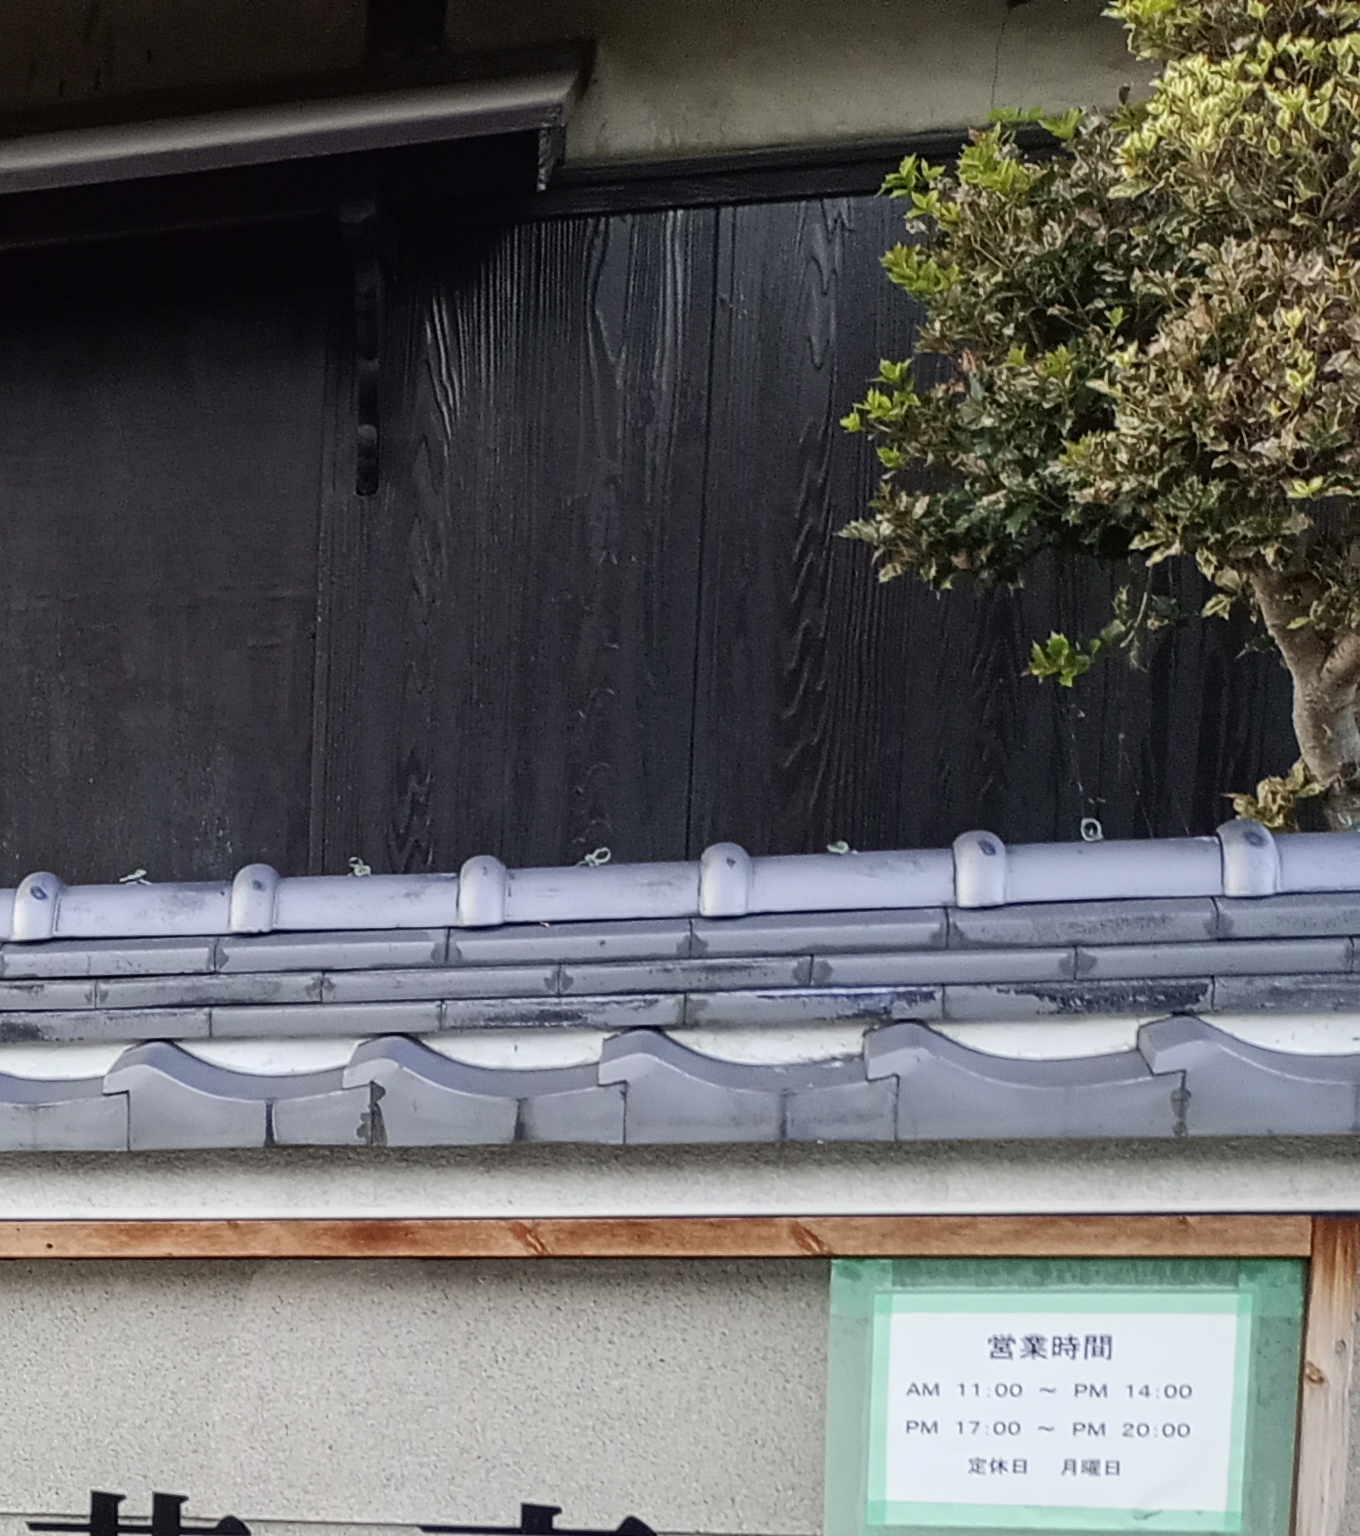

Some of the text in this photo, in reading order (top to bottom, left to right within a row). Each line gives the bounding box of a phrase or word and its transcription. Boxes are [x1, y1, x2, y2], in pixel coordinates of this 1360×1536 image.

[986, 1334, 1114, 1361] 営業時間
[905, 1382, 941, 1398] AM
[957, 1383, 1024, 1399] 11:00
[1073, 1383, 1109, 1399] PM
[1126, 1384, 1193, 1400] 14:00
[905, 1420, 939, 1436] PM
[956, 1420, 1022, 1437] 17:00
[1071, 1421, 1107, 1438] PM
[1121, 1423, 1192, 1439] 20:00
[967, 1457, 1121, 1477] 定休日 月曜日
